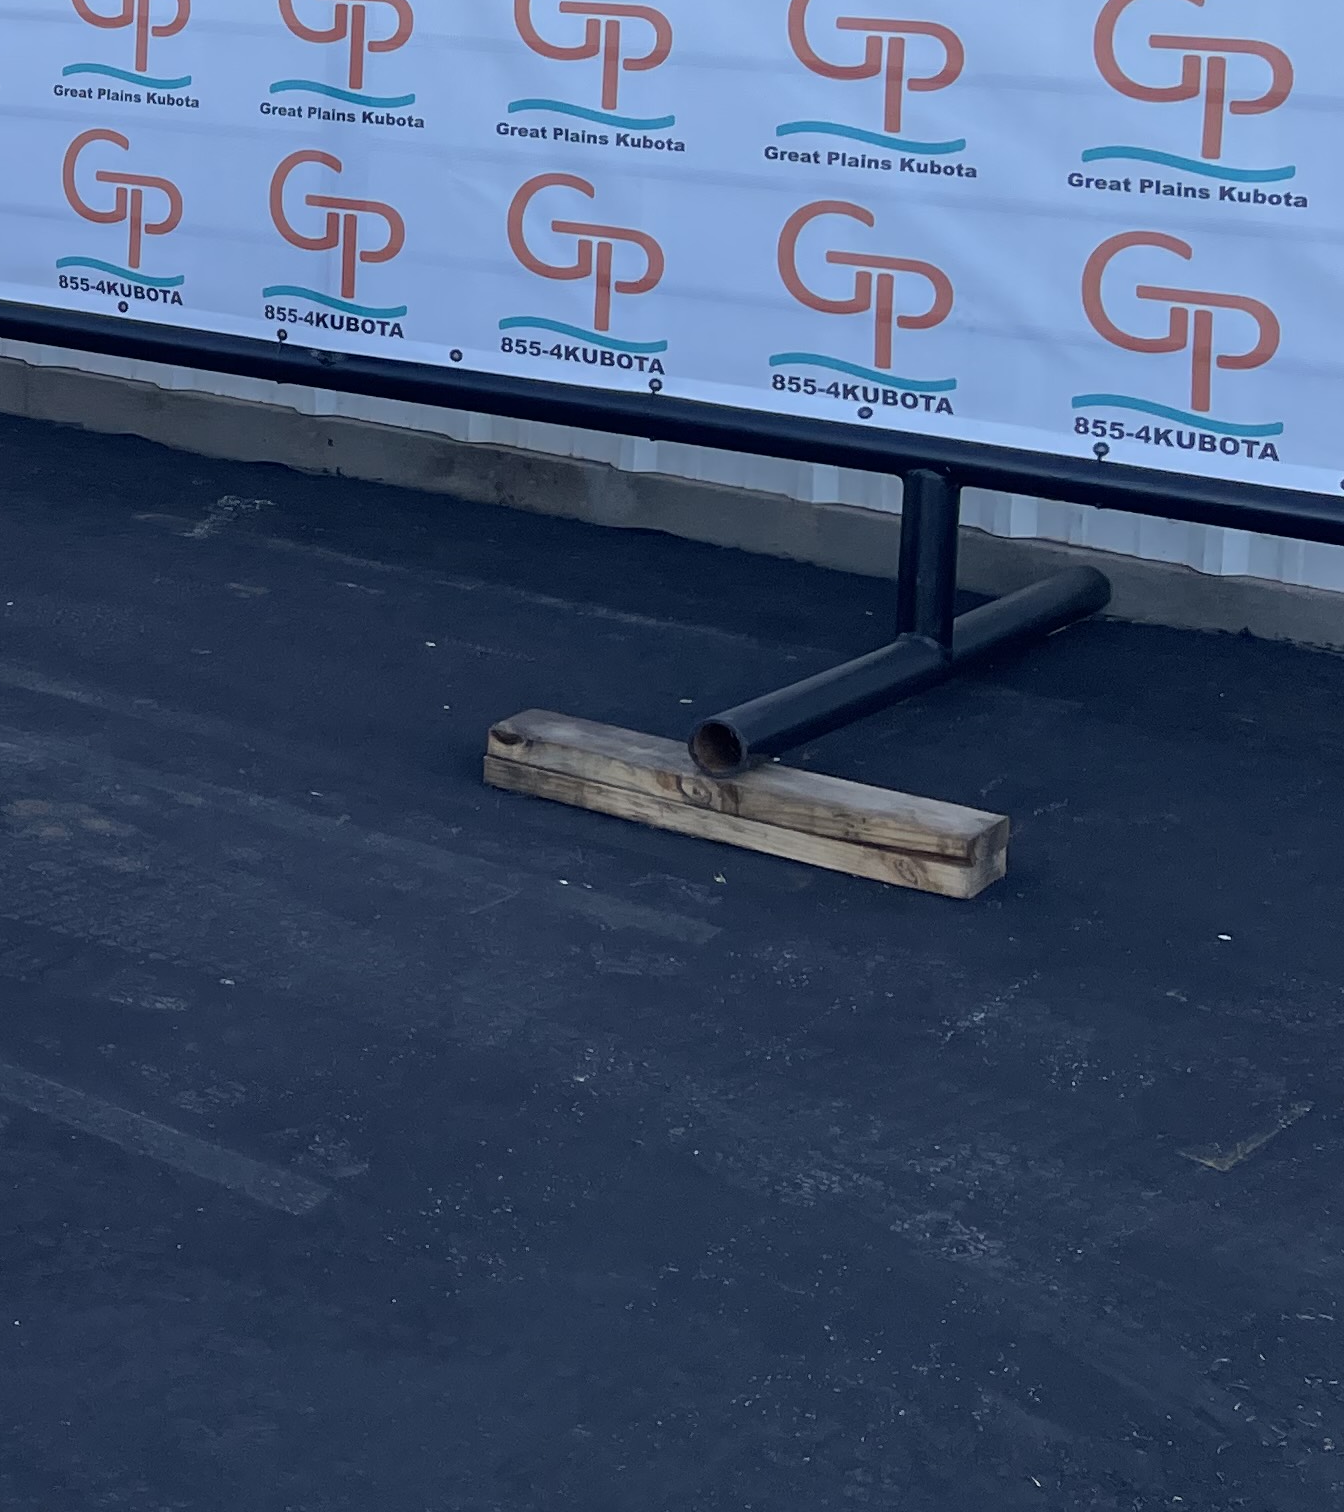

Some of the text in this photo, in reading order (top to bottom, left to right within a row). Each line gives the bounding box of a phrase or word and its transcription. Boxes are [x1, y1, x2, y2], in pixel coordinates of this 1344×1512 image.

[53, 84, 200, 109] Great Plains Kubota
[259, 102, 425, 129] Great Plains Kubota
[495, 122, 686, 153] Great Plains Kubota
[764, 145, 978, 179] Great Plains Kubota
[63, 129, 183, 269] GP
[1067, 172, 1308, 208] Great Plains Kubota
[270, 150, 405, 299] GP
[508, 173, 665, 331] GP
[58, 274, 184, 307] 855-4KUBOTA
[778, 200, 954, 369] GP
[264, 304, 405, 340] 855-4KUBOTA
[1082, 231, 1280, 412] GP
[500, 336, 666, 376] 855-4KUBOTA
[771, 373, 955, 416] 855-4KUBOTA
[1073, 416, 1281, 463] 855-4KUBOTA
